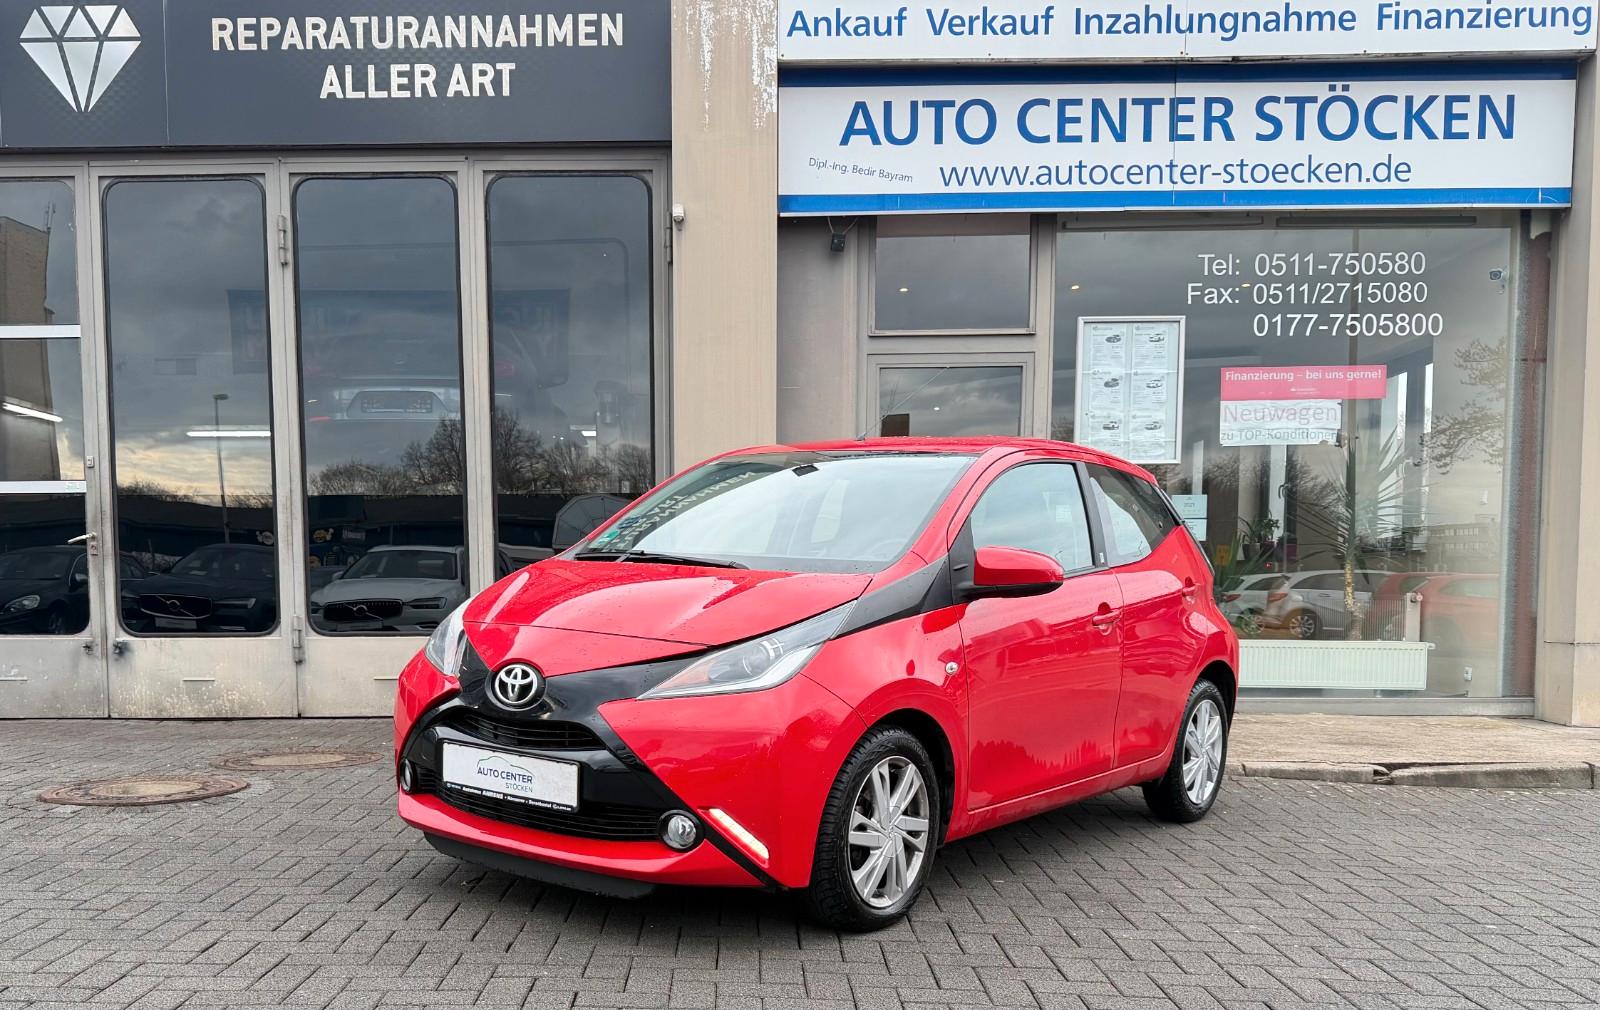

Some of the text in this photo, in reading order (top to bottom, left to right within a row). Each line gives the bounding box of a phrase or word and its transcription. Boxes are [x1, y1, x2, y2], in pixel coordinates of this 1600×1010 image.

[211, 13, 624, 51] REPARATURANNAHMEN
[786, 2, 1593, 41] Ankauf Verkauf Inzahlungnahme Finanzierung
[320, 62, 516, 99] ALLER ART
[839, 84, 1516, 147] AUTO CENTER STÖCKEN
[808, 157, 913, 183] Dipl.-Ing. Bedir Bayram
[939, 154, 1412, 187] www.autocenter-stoecken.de
[1198, 252, 1426, 276] Tel: 0511-750580
[1187, 281, 1428, 305] Fax: 0511/2715080
[1253, 313, 1444, 337] 0177-7505800
[1225, 370, 1294, 382] Finanzierung
[1305, 370, 1322, 381] bei
[1325, 371, 1344, 380] uns
[1347, 369, 1382, 382] gerne!
[1223, 404, 1338, 426] Neuwagen
[1221, 432, 1234, 442] zu
[477, 767, 533, 784] AUTO CENTER
